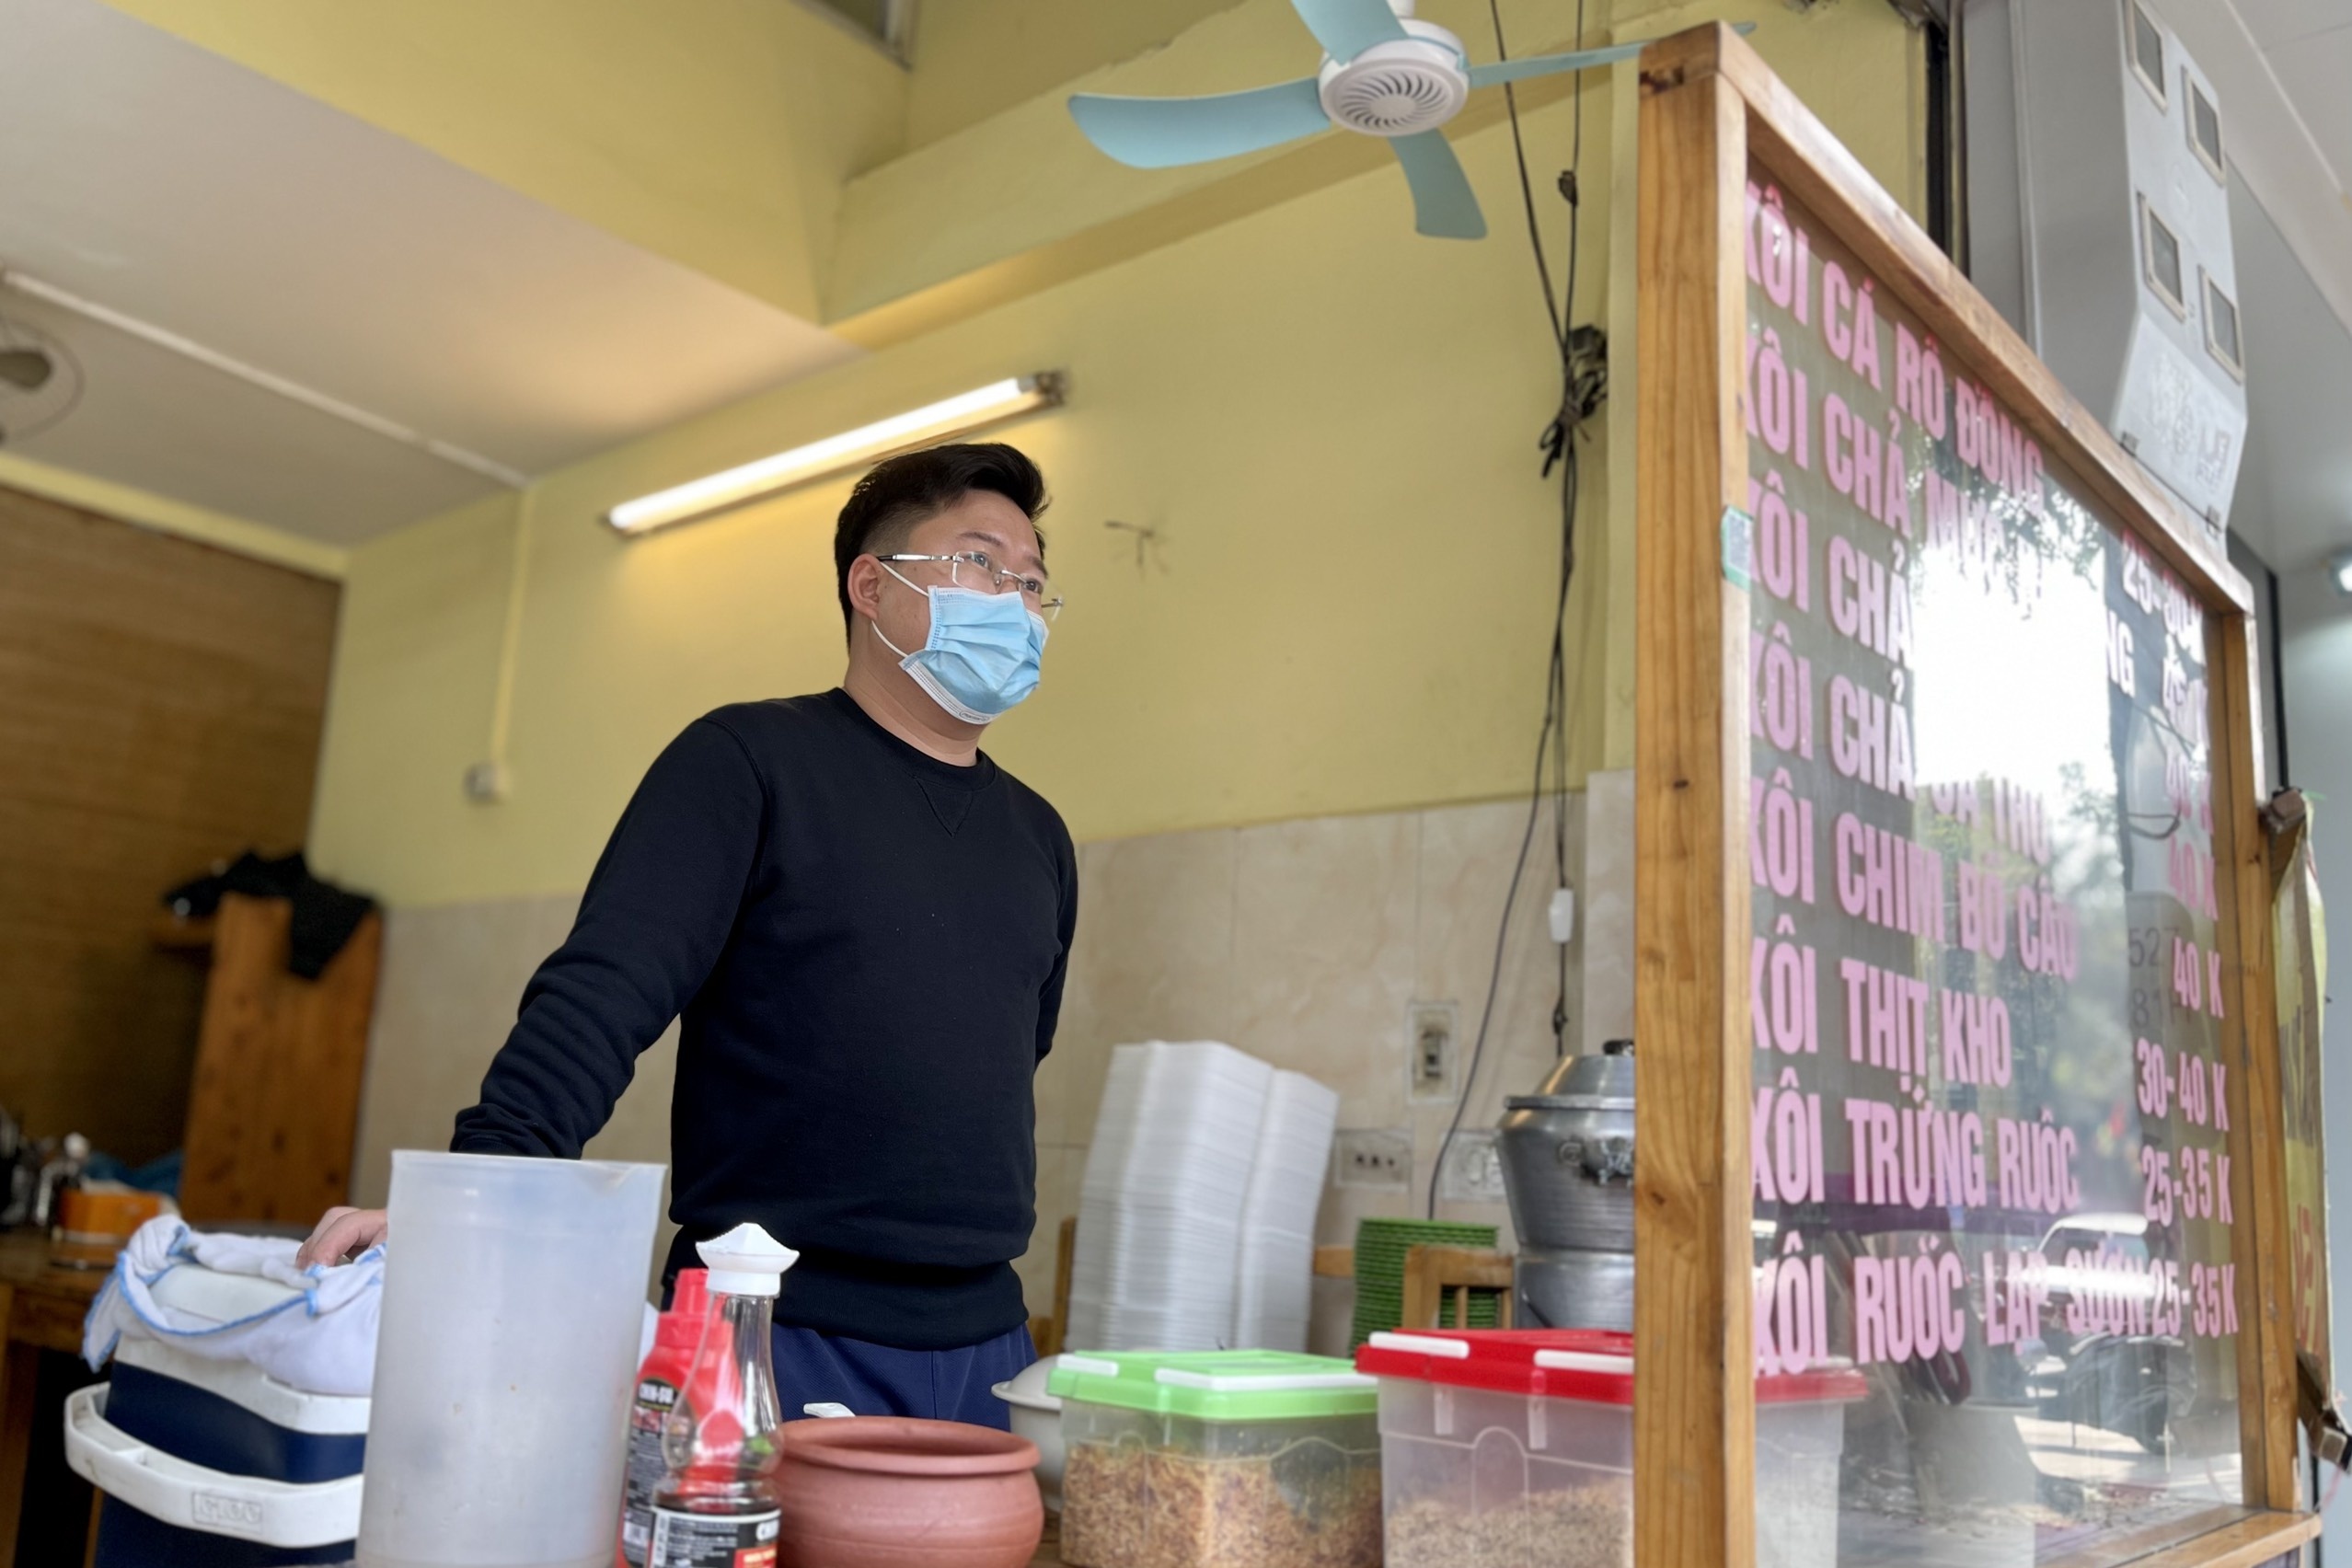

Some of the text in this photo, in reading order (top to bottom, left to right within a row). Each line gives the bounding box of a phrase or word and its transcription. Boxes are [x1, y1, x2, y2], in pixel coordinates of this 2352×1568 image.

[1823, 260, 1883, 391] CÁ
[1824, 393, 1912, 540] CHẢ
[1828, 534, 1913, 671] CHẢ
[1829, 668, 1916, 800] CHẢ
[1836, 812, 1945, 944] CHIM
[2173, 936, 2201, 1011] 40
[2208, 950, 2225, 1020] K
[1841, 956, 1929, 1093] THỊT
[1942, 987, 2012, 1089] KHO
[2137, 1038, 2207, 1127] 30-40
[2213, 1061, 2230, 1132] K
[1751, 1066, 1825, 1205] XÔI
[1845, 1083, 1988, 1210] TRỨNG
[1753, 1230, 1828, 1379] XÔI
[1854, 1234, 1966, 1365] RUỐC
